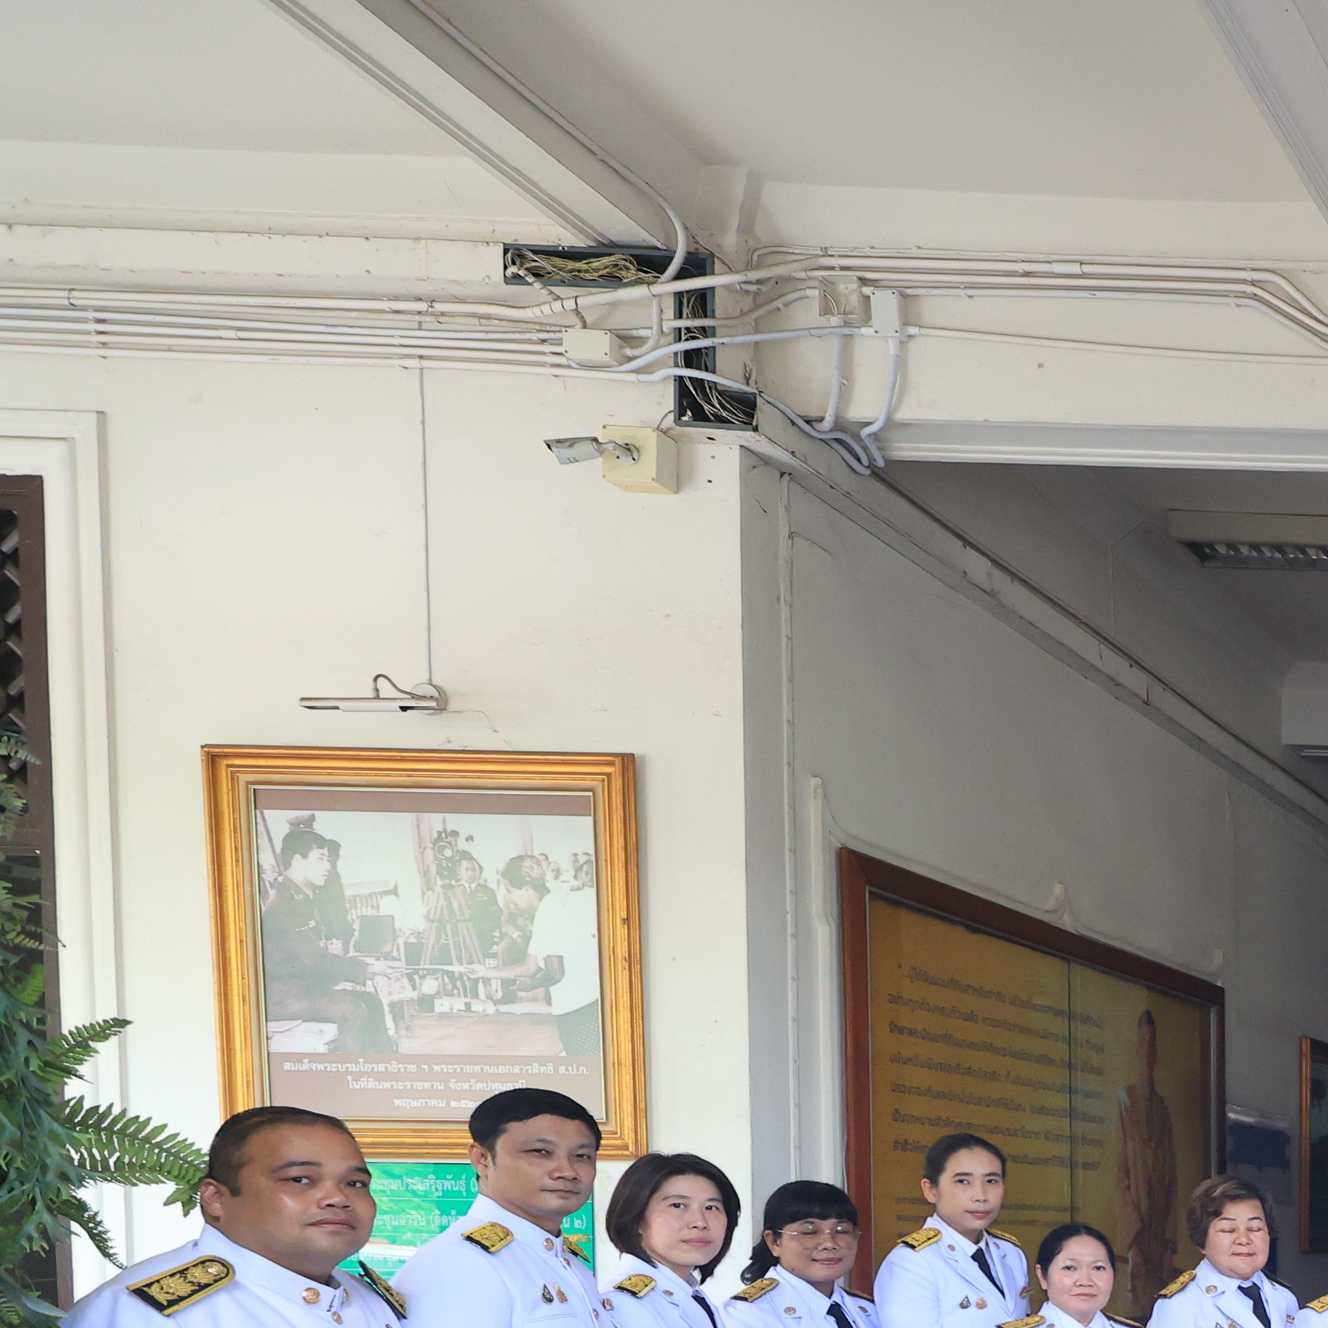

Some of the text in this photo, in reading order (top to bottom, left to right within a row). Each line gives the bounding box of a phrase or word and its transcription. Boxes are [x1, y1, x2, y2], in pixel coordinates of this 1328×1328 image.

[558, 1064, 590, 1075] ส.ป.ก.
[346, 1075, 444, 1091] ในที่ดินพระราชทาน
